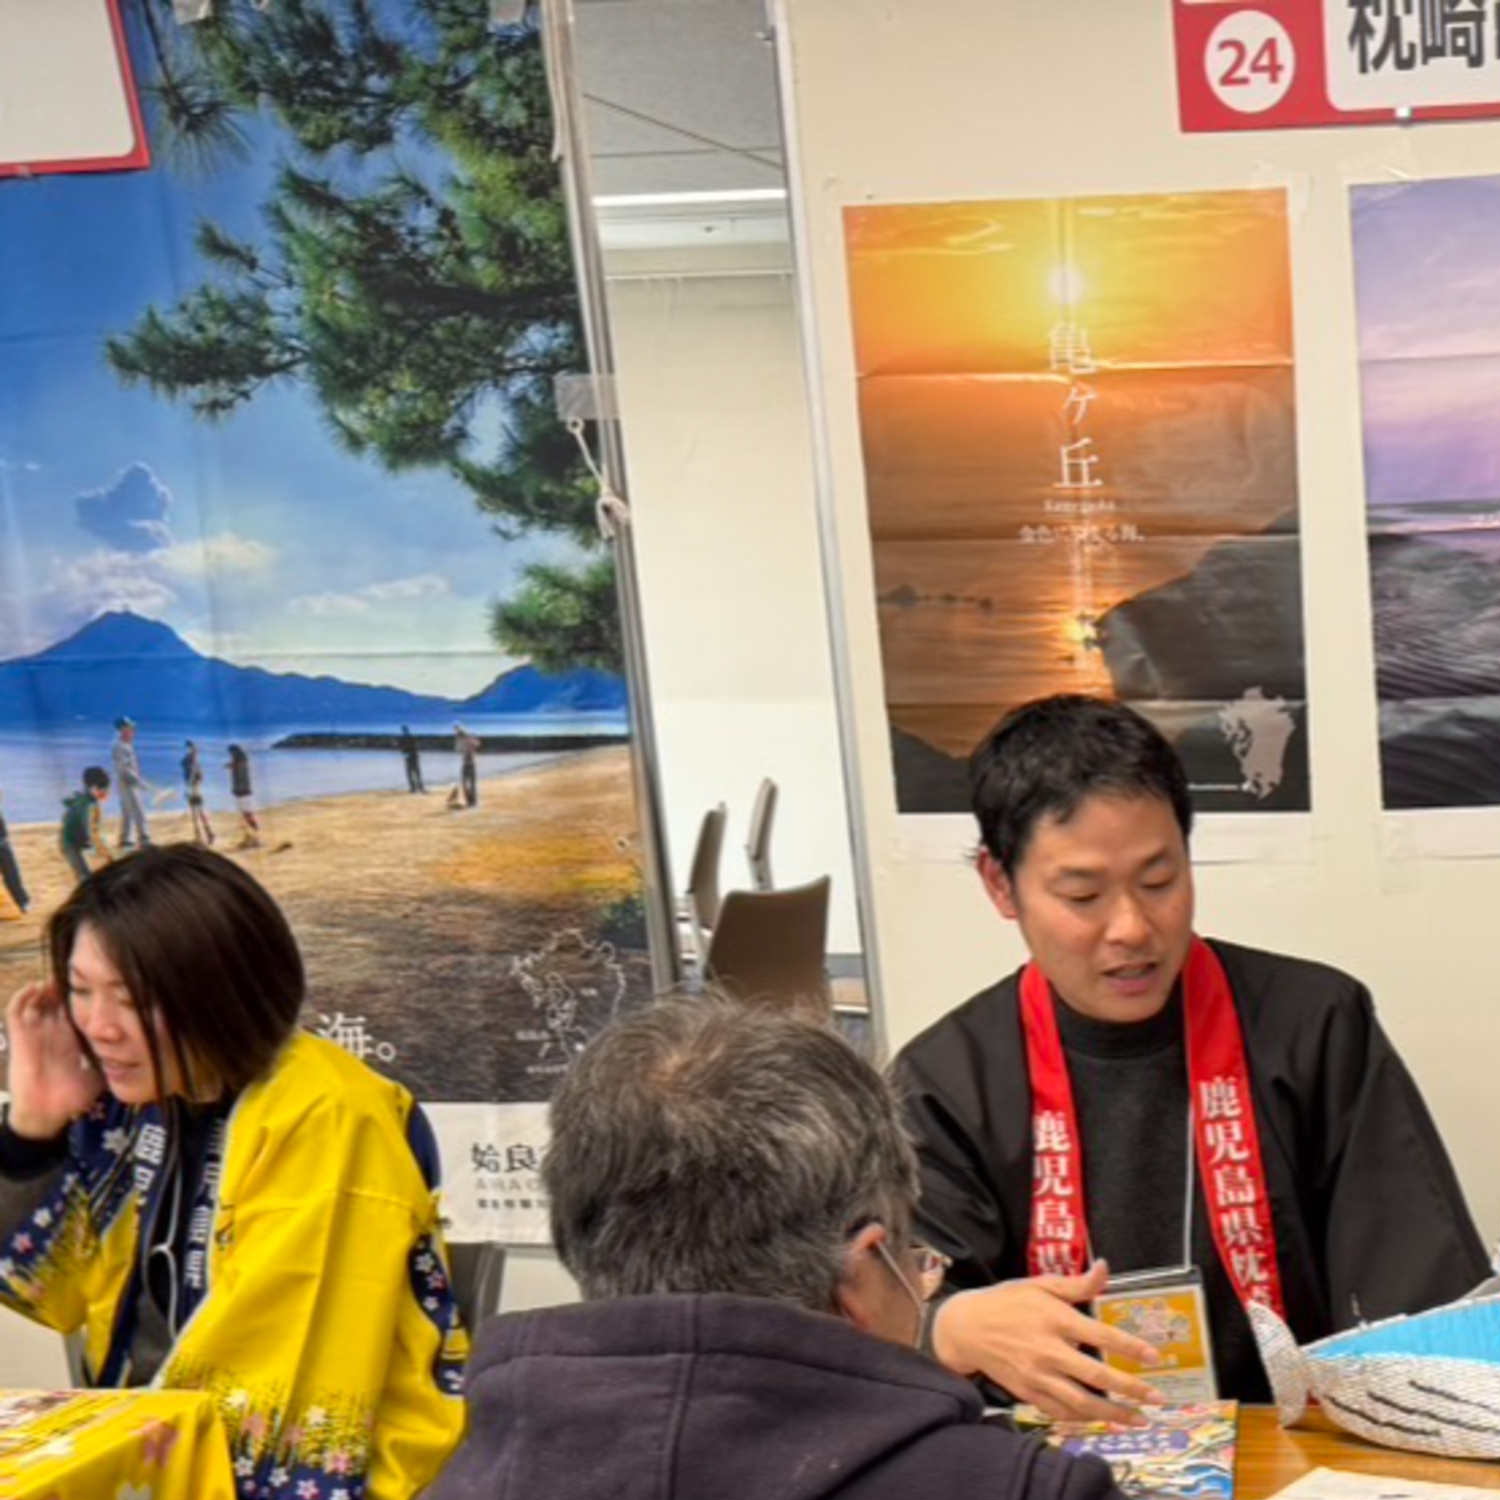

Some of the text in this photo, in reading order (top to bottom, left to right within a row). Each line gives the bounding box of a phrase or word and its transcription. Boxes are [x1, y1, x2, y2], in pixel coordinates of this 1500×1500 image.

[1217, 38, 1284, 87] 24
[471, 1142, 546, 1174] 姶良
[1032, 1110, 1078, 1276] 鹿児島県
